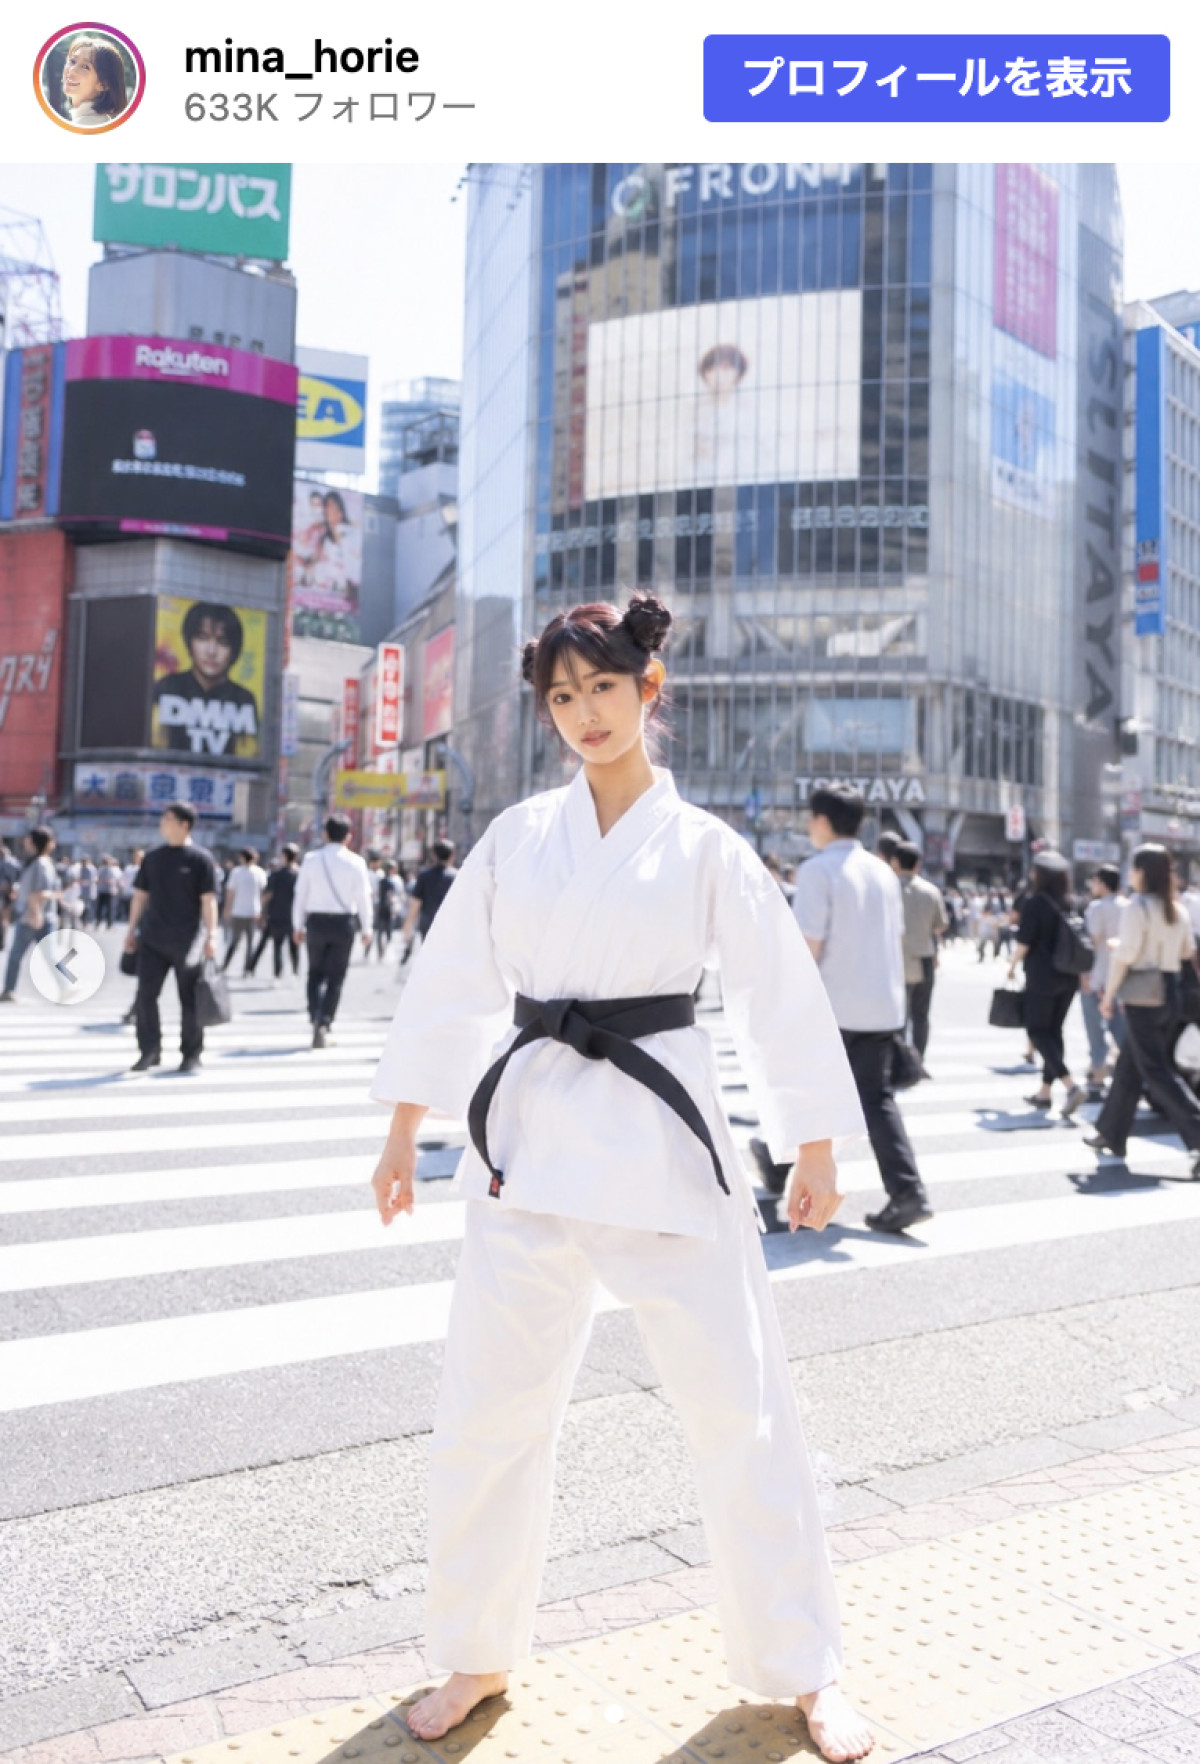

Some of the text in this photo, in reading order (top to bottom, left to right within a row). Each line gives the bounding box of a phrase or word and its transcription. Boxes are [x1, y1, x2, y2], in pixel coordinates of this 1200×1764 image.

[105, 163, 281, 222] サロンパス
[135, 344, 229, 377] Rakuten
[159, 694, 257, 734] DMM
[187, 730, 230, 756] TV
